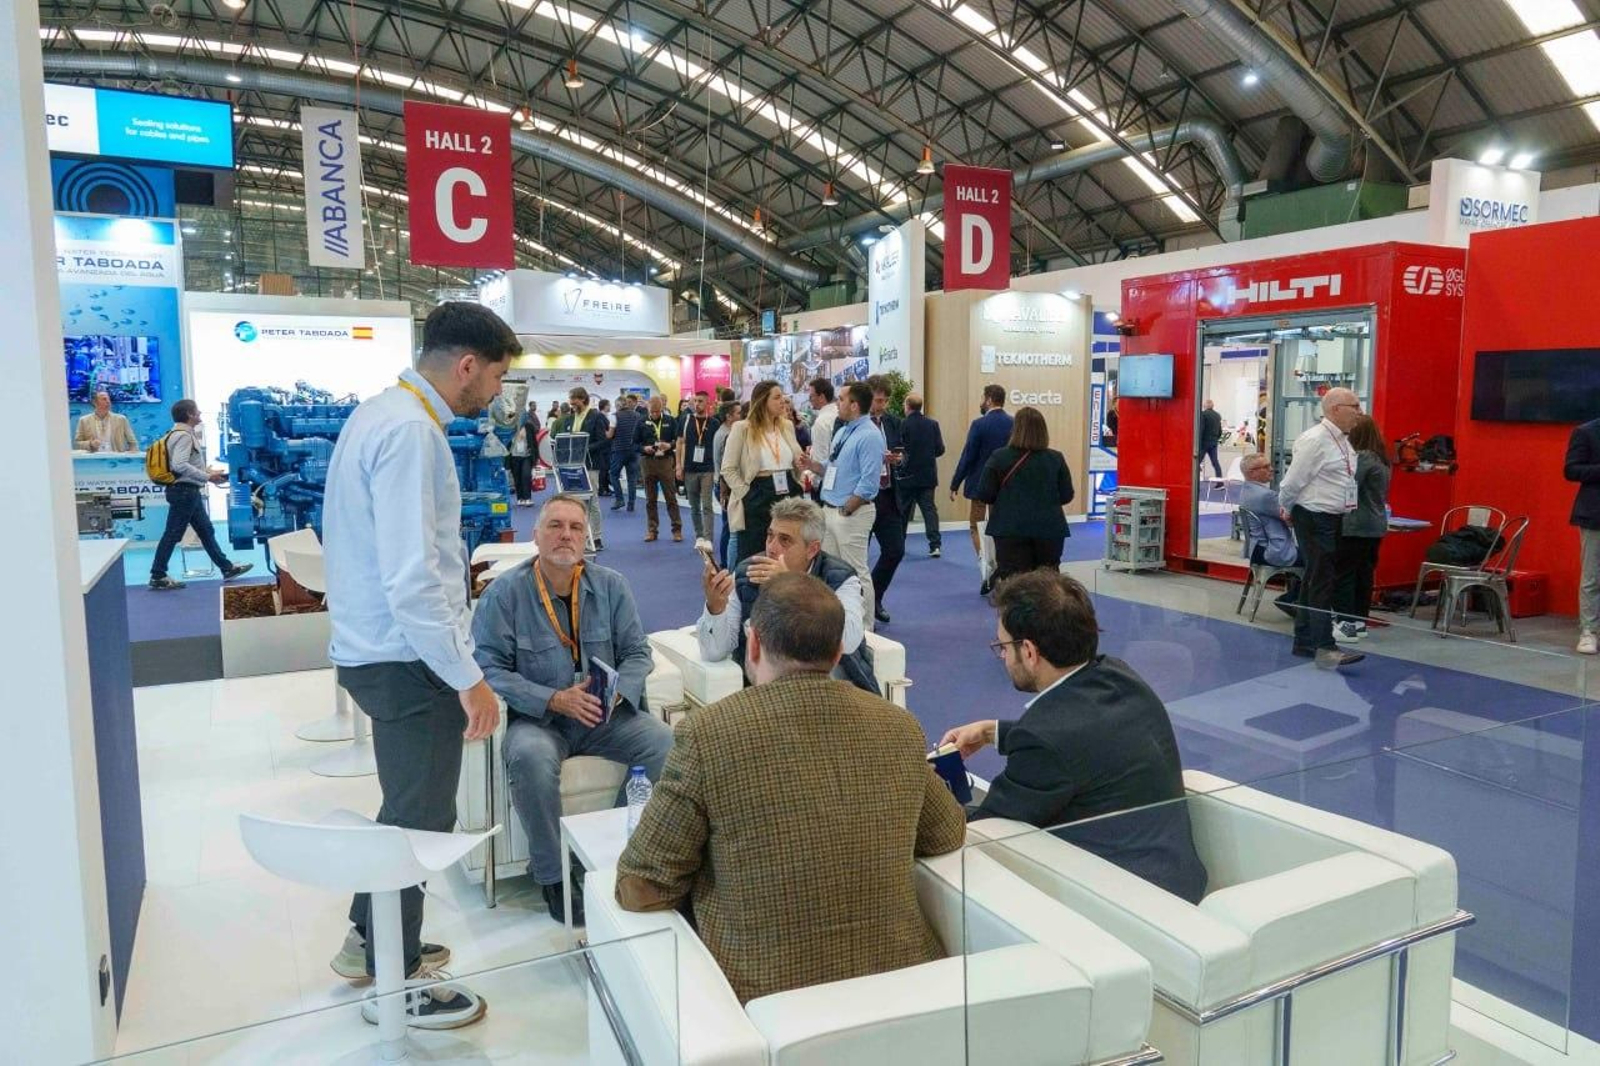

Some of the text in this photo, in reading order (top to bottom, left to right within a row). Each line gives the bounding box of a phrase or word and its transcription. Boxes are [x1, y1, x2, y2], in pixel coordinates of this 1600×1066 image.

[425, 129, 493, 155] HALL 2
[435, 167, 488, 243] C
[956, 186, 999, 204] HALL 2
[1473, 199, 1528, 223] SORMEC
[961, 213, 994, 274] D
[73, 256, 164, 270] TABOADA
[1227, 273, 1342, 305] HILTI
[583, 299, 631, 312] FREIRE
[261, 328, 349, 337] PETER TABOADA
[1010, 389, 1062, 405] Exacta
